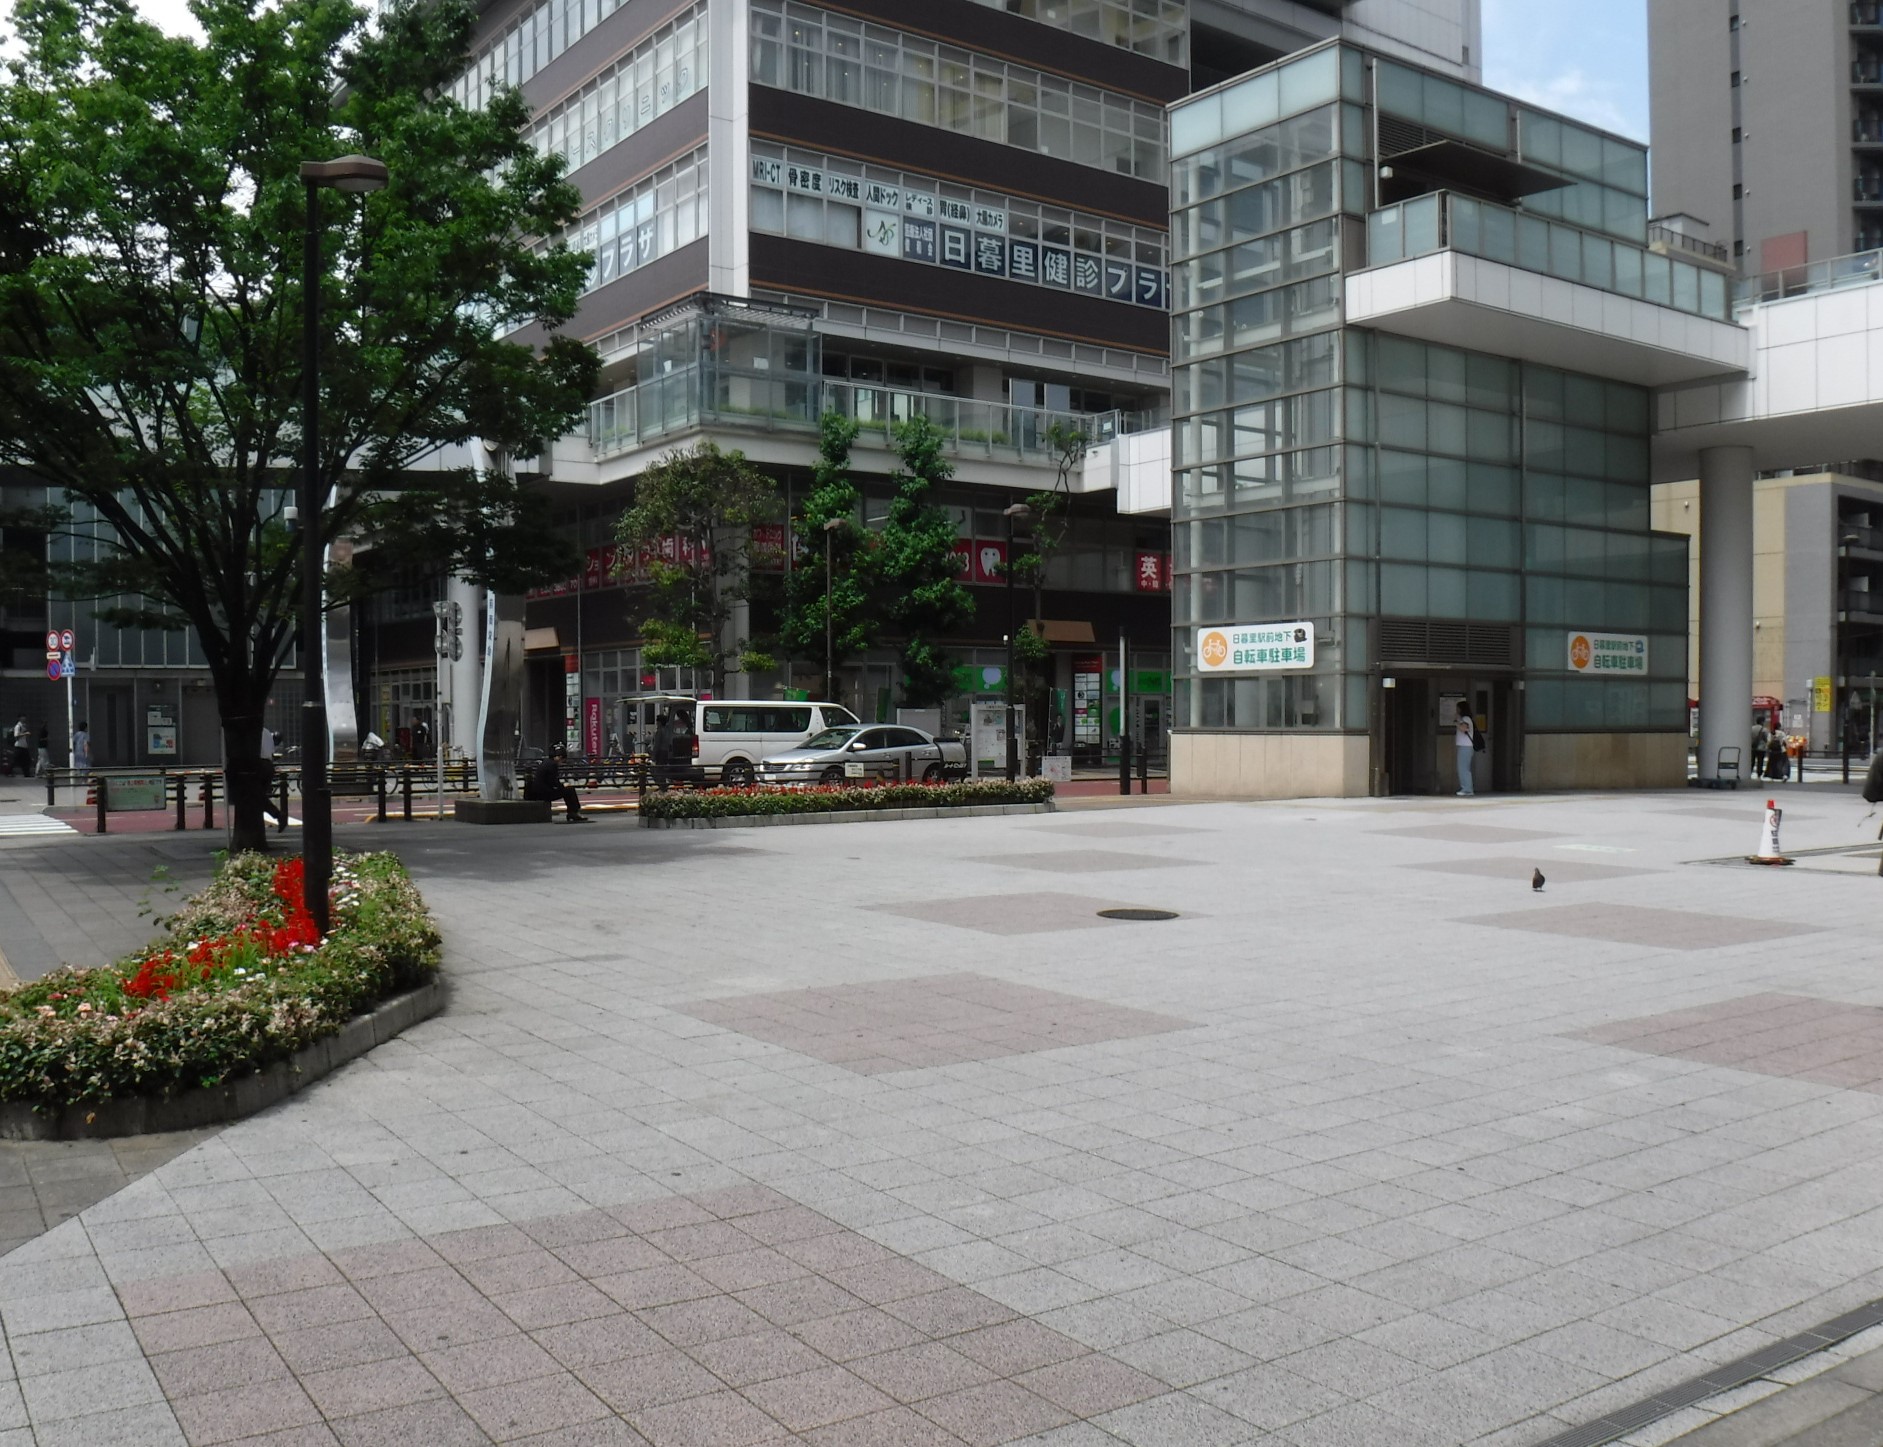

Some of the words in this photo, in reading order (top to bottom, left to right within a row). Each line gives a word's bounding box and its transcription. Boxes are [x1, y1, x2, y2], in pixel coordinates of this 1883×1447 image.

[788, 168, 822, 192] 骨密度
[829, 176, 859, 199] リスク検査
[866, 184, 899, 207] 人間ドック
[905, 192, 933, 206] レディース
[944, 230, 1170, 300] 日暮里健診プラ
[1233, 631, 1291, 644] 日暮里駅前地下
[1233, 647, 1306, 664] 自転車駐車場
[1594, 655, 1643, 670] 自転車駐車場
